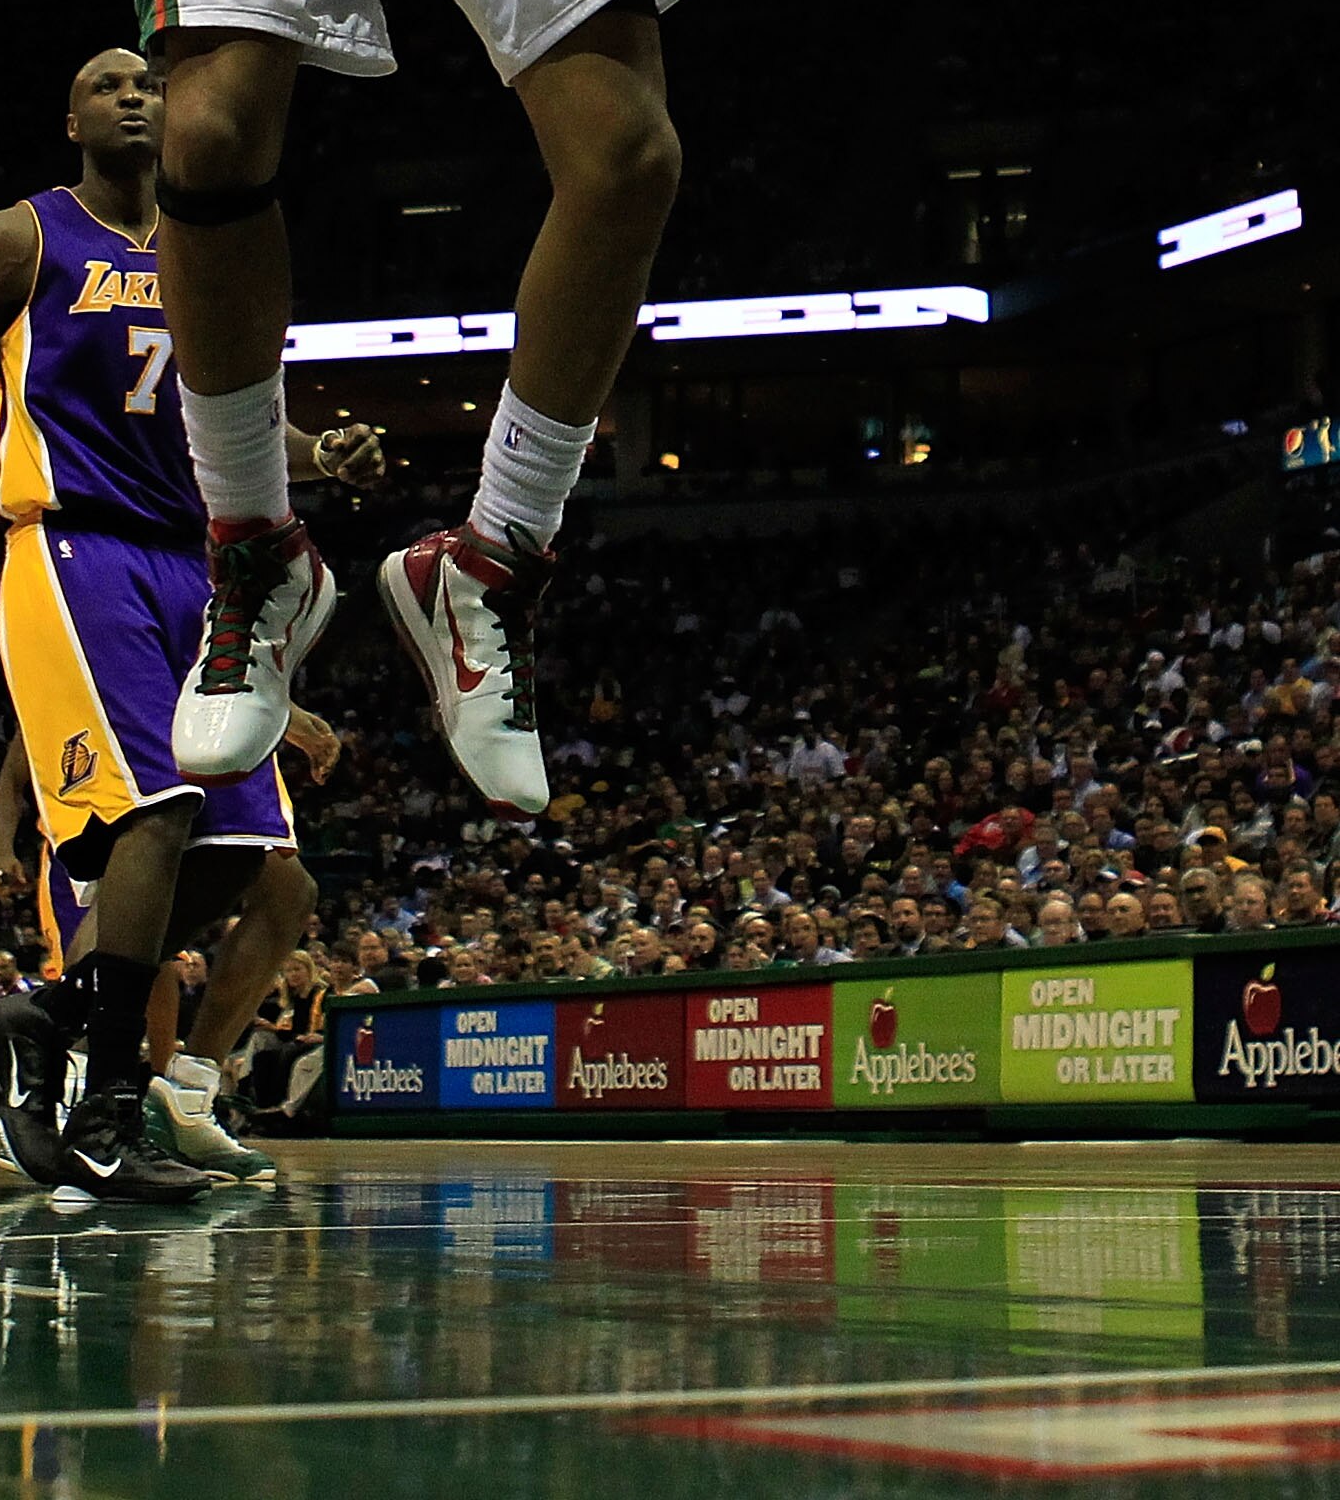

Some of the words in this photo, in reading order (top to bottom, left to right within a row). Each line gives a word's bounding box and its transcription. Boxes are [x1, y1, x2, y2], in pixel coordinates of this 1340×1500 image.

[125, 326, 174, 414] 7
[1030, 978, 1094, 1008] OPEN
[456, 1011, 497, 1033] OPEN
[709, 997, 759, 1023] OPEN
[695, 1024, 824, 1062] MIDNIGHT
[1011, 1009, 1181, 1051] MIDNIGHT
[445, 1035, 549, 1068] MIDNIGHT
[850, 1035, 976, 1094] Applebee's
[342, 1054, 423, 1100] Applebee's
[472, 1073, 495, 1094] OR
[497, 1070, 546, 1094] LATER
[568, 1045, 668, 1099] Applebee's
[728, 1066, 757, 1091] OR
[759, 1064, 821, 1092] LATER
[1057, 1057, 1090, 1083] OR
[1095, 1054, 1175, 1084] LATER
